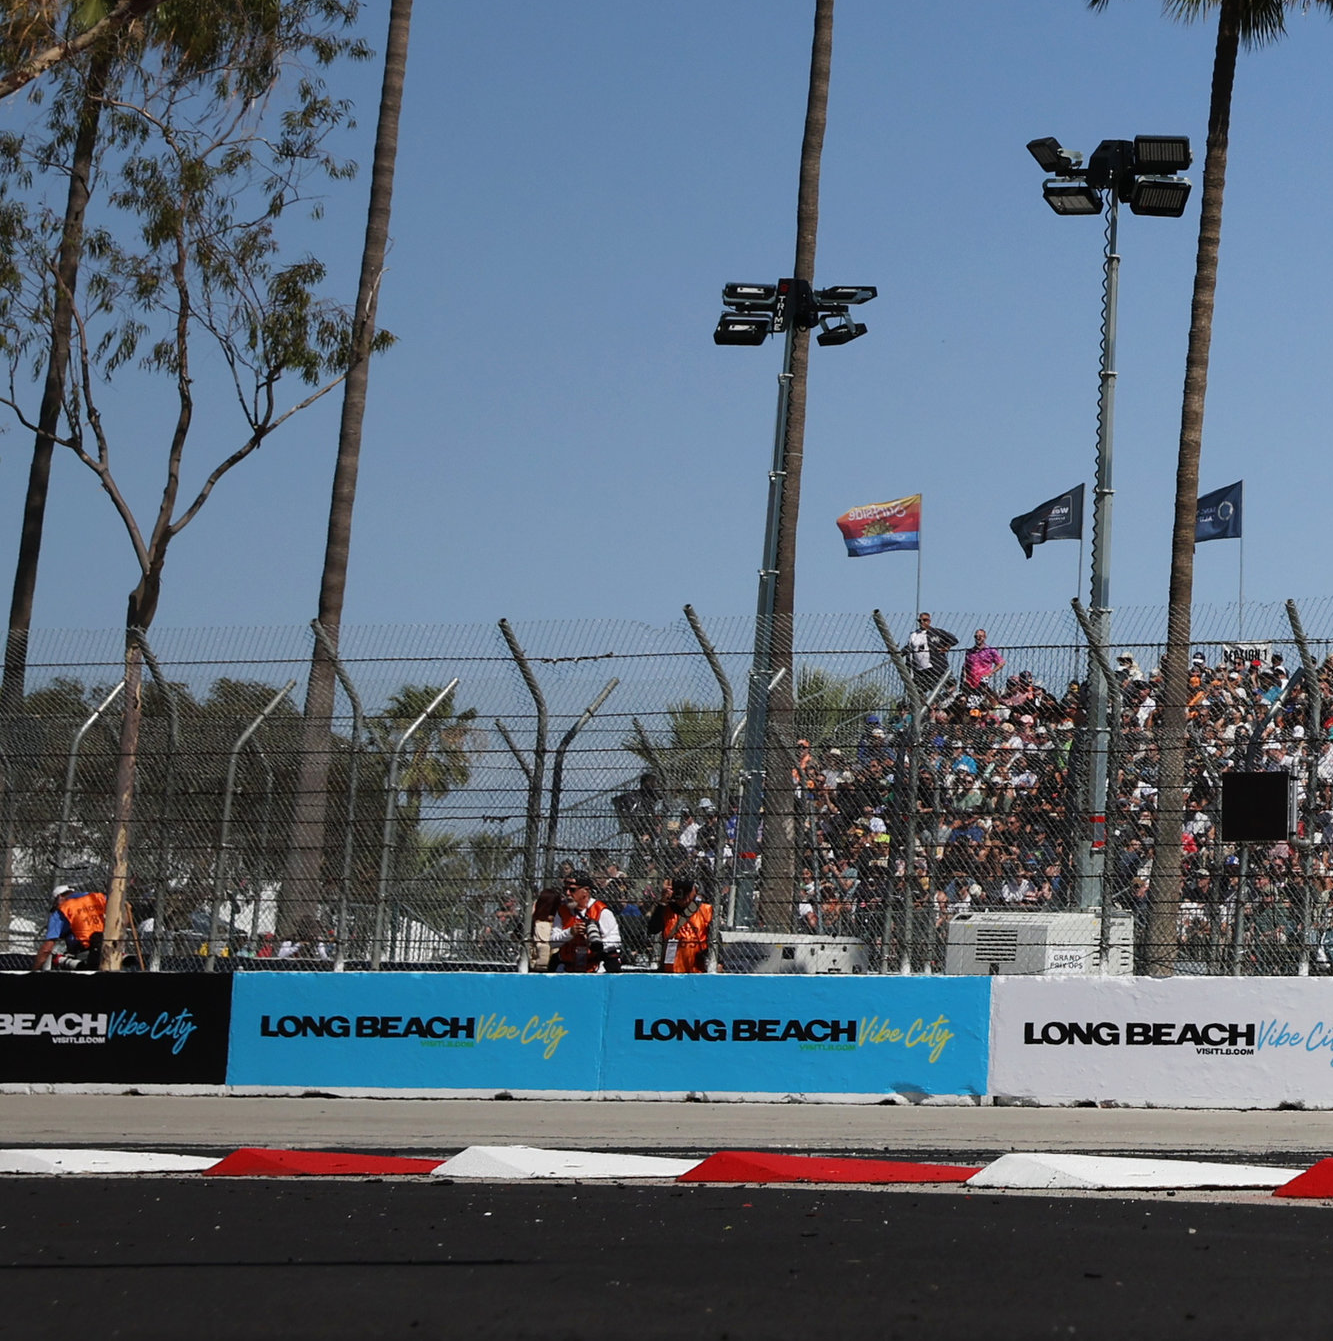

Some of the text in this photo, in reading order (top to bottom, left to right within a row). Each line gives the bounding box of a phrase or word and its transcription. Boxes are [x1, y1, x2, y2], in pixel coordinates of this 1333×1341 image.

[108, 1009, 150, 1040] Vibe
[150, 1008, 198, 1055] City
[260, 1012, 569, 1060] LONG BEACH Vibe City
[634, 1014, 955, 1064] LONG BEACH Vibe City
[1024, 1021, 1120, 1046] LONG
[1126, 1022, 1255, 1047] BEACH
[1257, 1019, 1304, 1051] Vibe
[1196, 1047, 1254, 1056] VISITLB.COM
